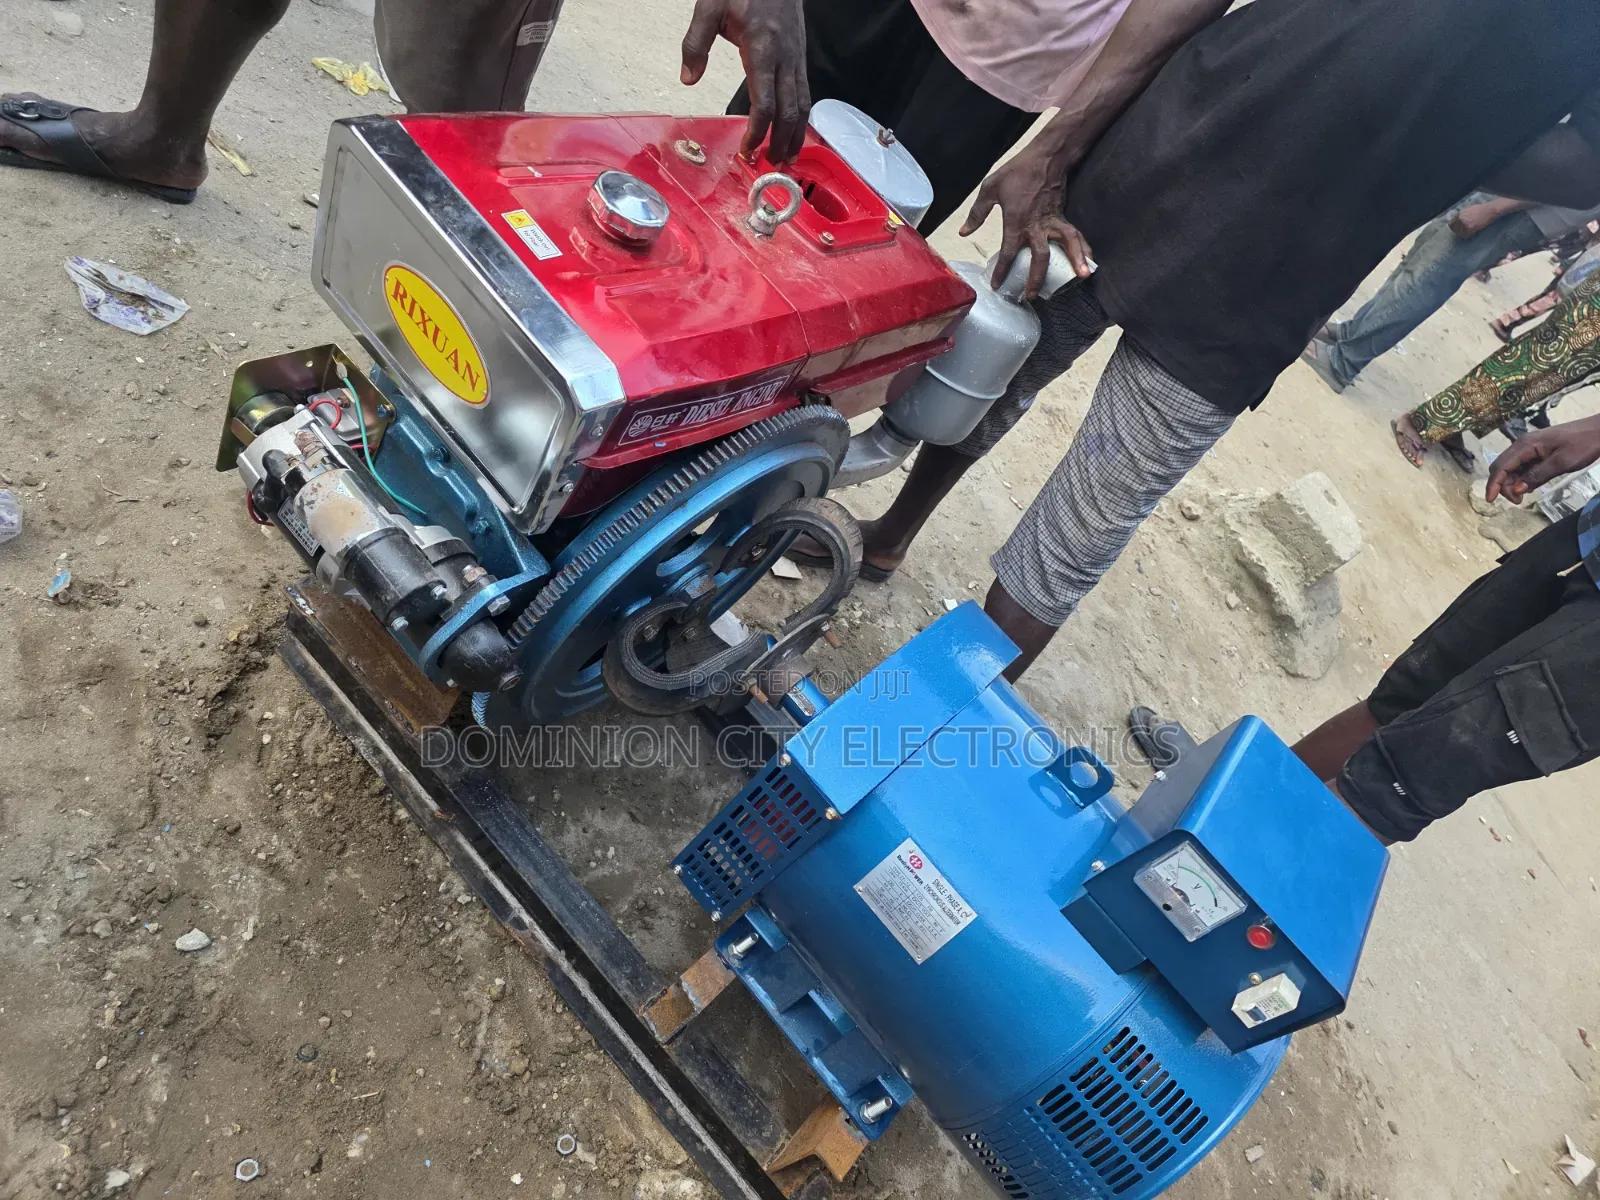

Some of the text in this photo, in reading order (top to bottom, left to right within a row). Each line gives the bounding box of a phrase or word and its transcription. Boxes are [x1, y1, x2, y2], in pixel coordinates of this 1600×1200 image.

[391, 276, 481, 392] RIXUAN
[679, 380, 784, 426] DIESEL ENGINE
